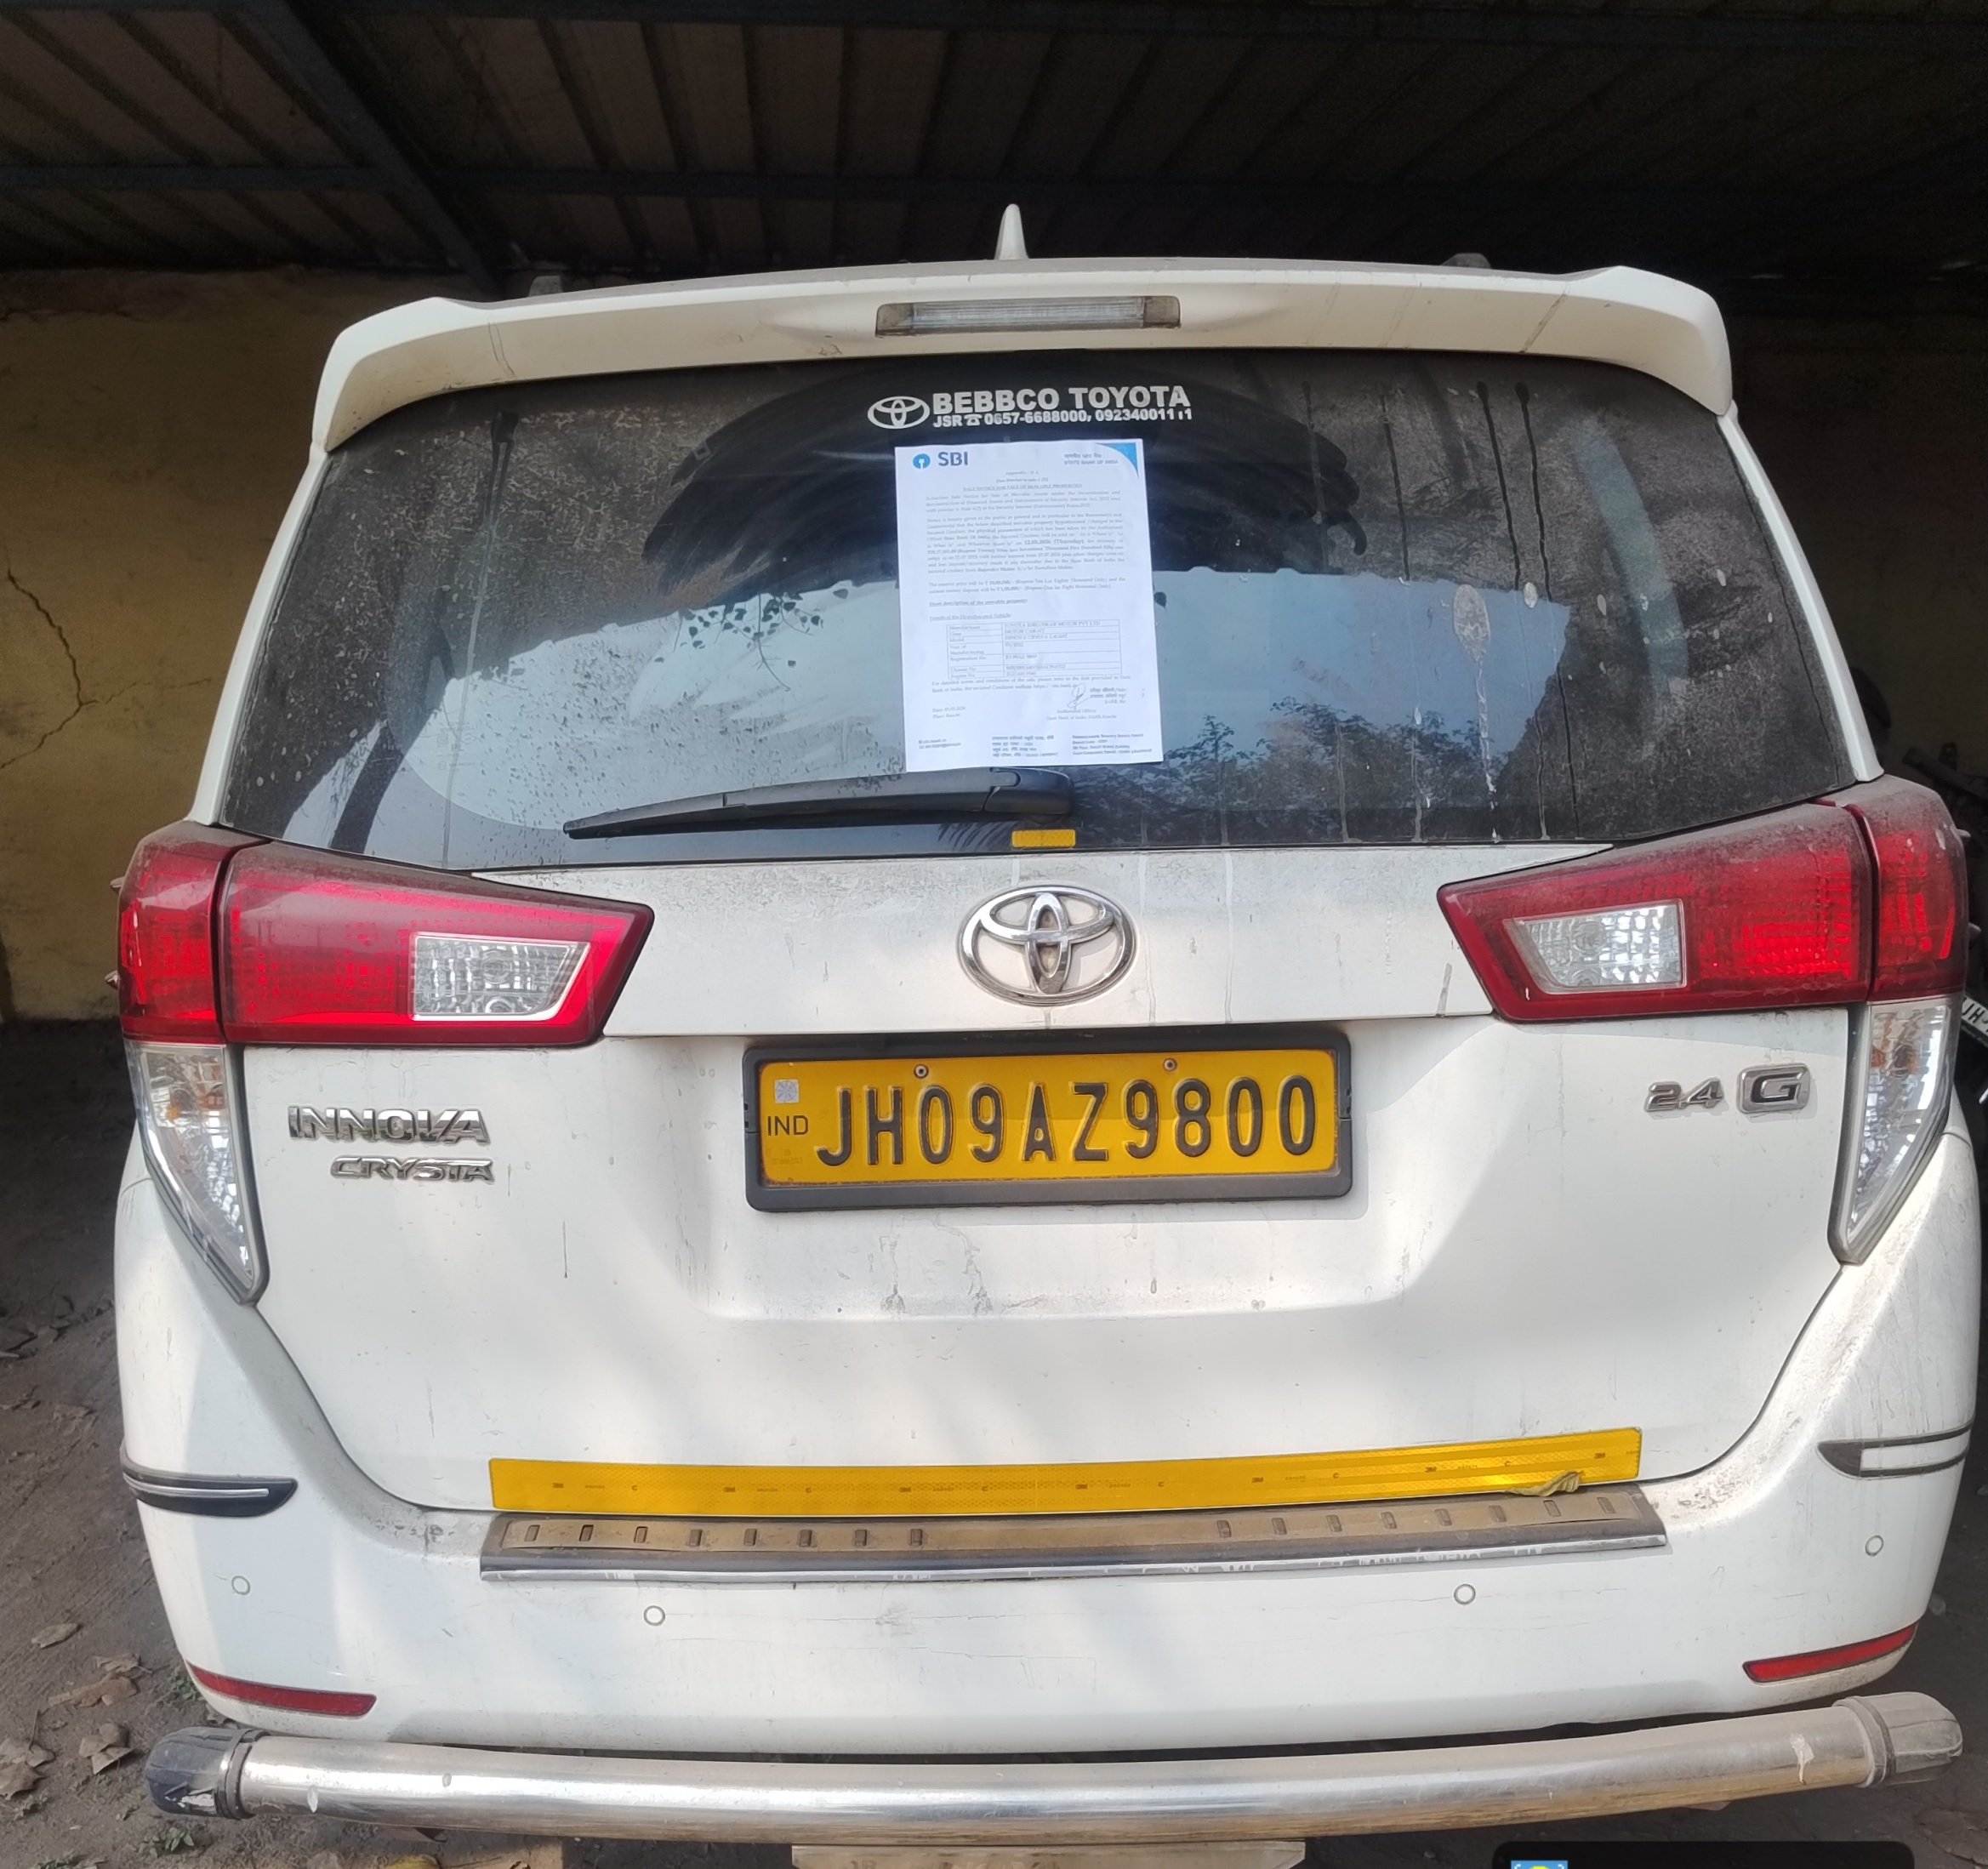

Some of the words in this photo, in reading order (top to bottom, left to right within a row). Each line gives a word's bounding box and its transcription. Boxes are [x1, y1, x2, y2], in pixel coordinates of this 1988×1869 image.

[932, 387, 1060, 415] BEBBCO
[1068, 385, 1191, 409] TOYOTA
[932, 414, 963, 428] JSR
[937, 451, 969, 466] SBI
[1745, 1068, 1805, 1108] G
[287, 1104, 492, 1146] INNOVA
[767, 1114, 809, 1136] IND
[814, 1074, 1319, 1167] JH09AZ9800
[329, 1154, 495, 1186] CRYSTA
